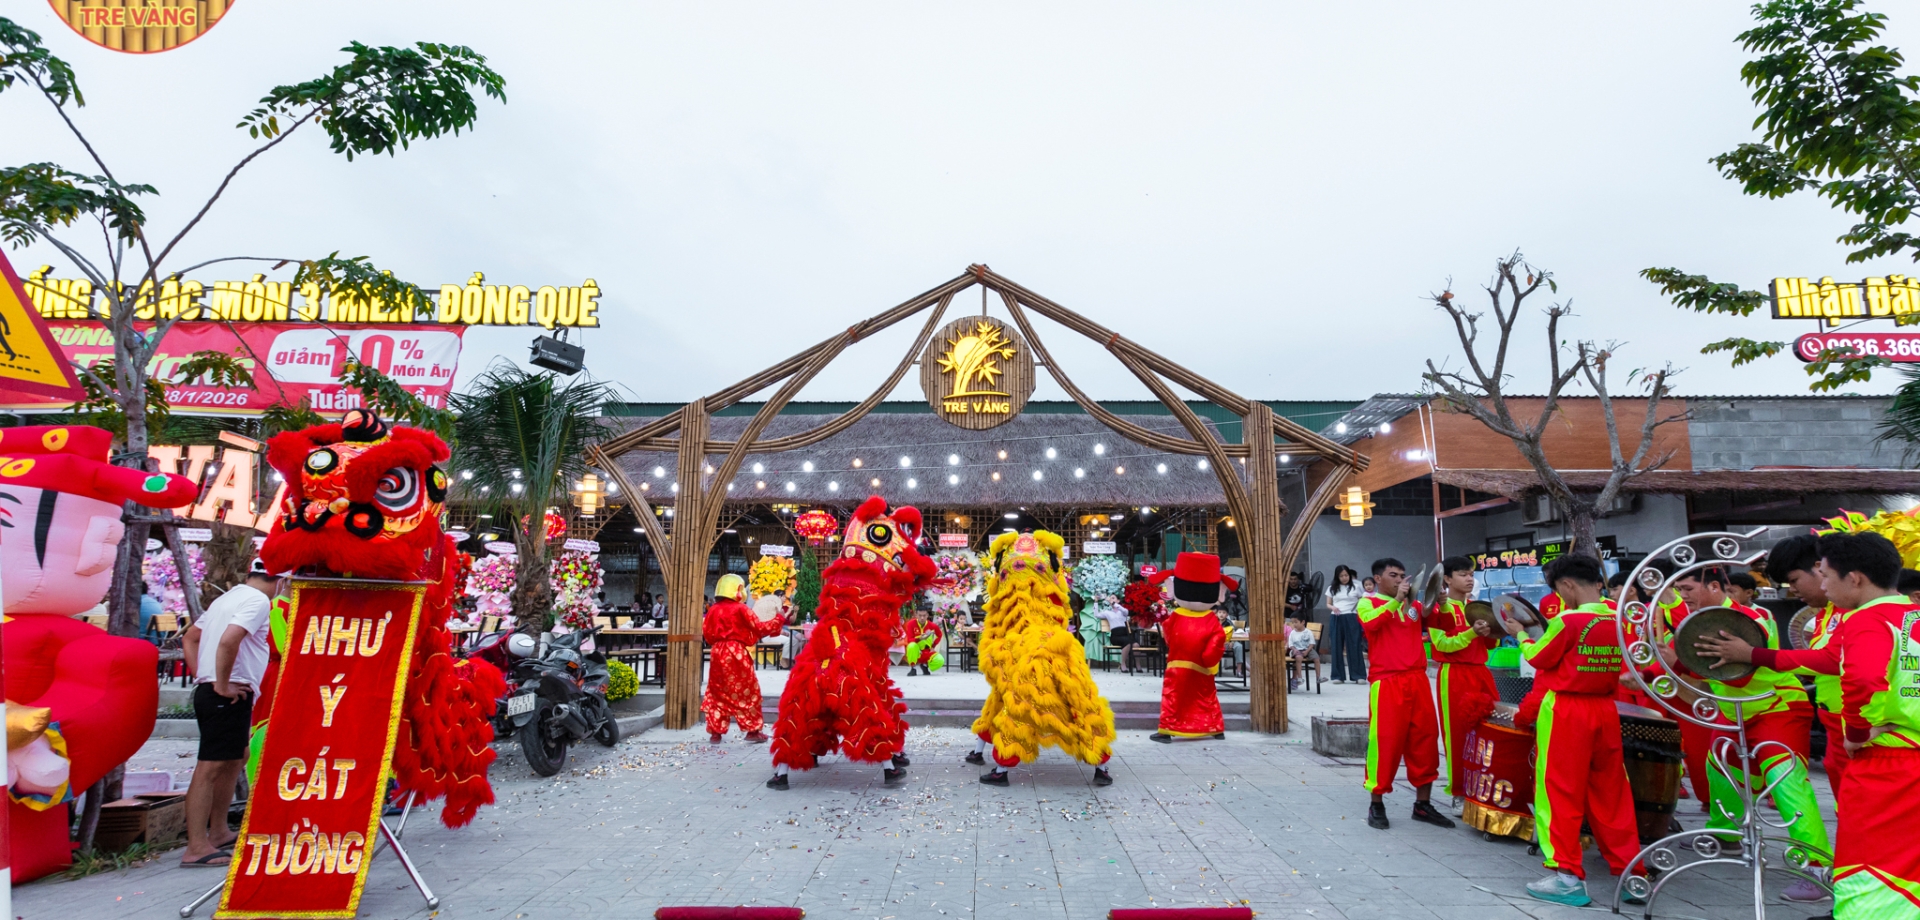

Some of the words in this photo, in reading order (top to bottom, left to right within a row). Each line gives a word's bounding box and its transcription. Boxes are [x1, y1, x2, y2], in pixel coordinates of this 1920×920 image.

[136, 272, 203, 320] CÁC
[210, 273, 291, 321] MÓN
[298, 281, 320, 322] 3
[438, 271, 532, 326] ĐỒNG
[535, 278, 600, 330] QUÊ
[1774, 275, 1862, 326] Nhận
[1865, 273, 1920, 325] Đặt
[274, 347, 331, 366] giảm
[392, 363, 426, 377] Món
[429, 362, 451, 378] Ăn
[943, 401, 968, 413] TRE
[972, 399, 1011, 414] VÀNG
[1477, 553, 1498, 570] Tre
[1500, 549, 1538, 568] Vàng
[300, 611, 393, 657] NHƯ
[1577, 644, 1593, 655] TÂN
[319, 673, 348, 727] Ý
[1463, 729, 1494, 768] ÂN
[277, 746, 356, 801] CÁT
[245, 818, 365, 876] TƯỜNG
